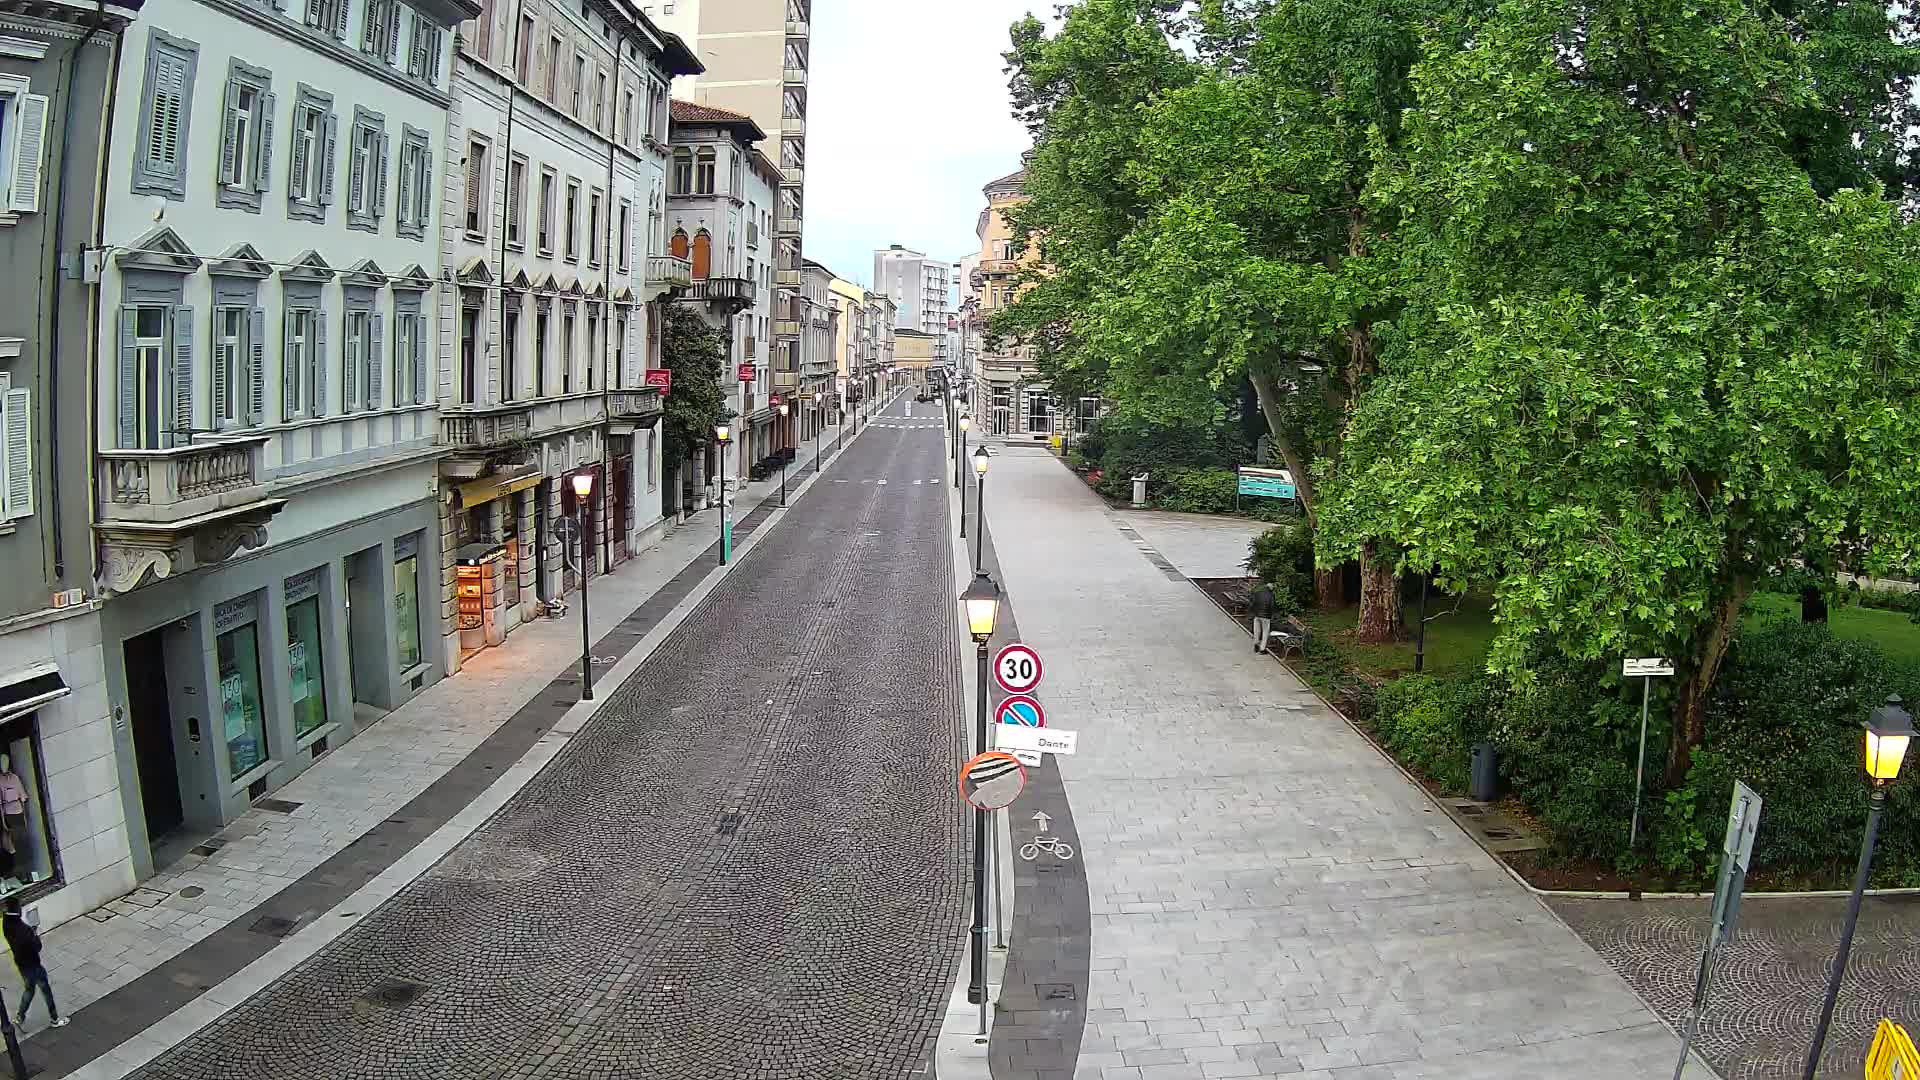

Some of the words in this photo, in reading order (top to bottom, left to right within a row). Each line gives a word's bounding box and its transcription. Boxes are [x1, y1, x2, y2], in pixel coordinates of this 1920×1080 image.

[1006, 658, 1032, 679] 30
[222, 677, 241, 699] 130
[1038, 738, 1069, 748] Dante
